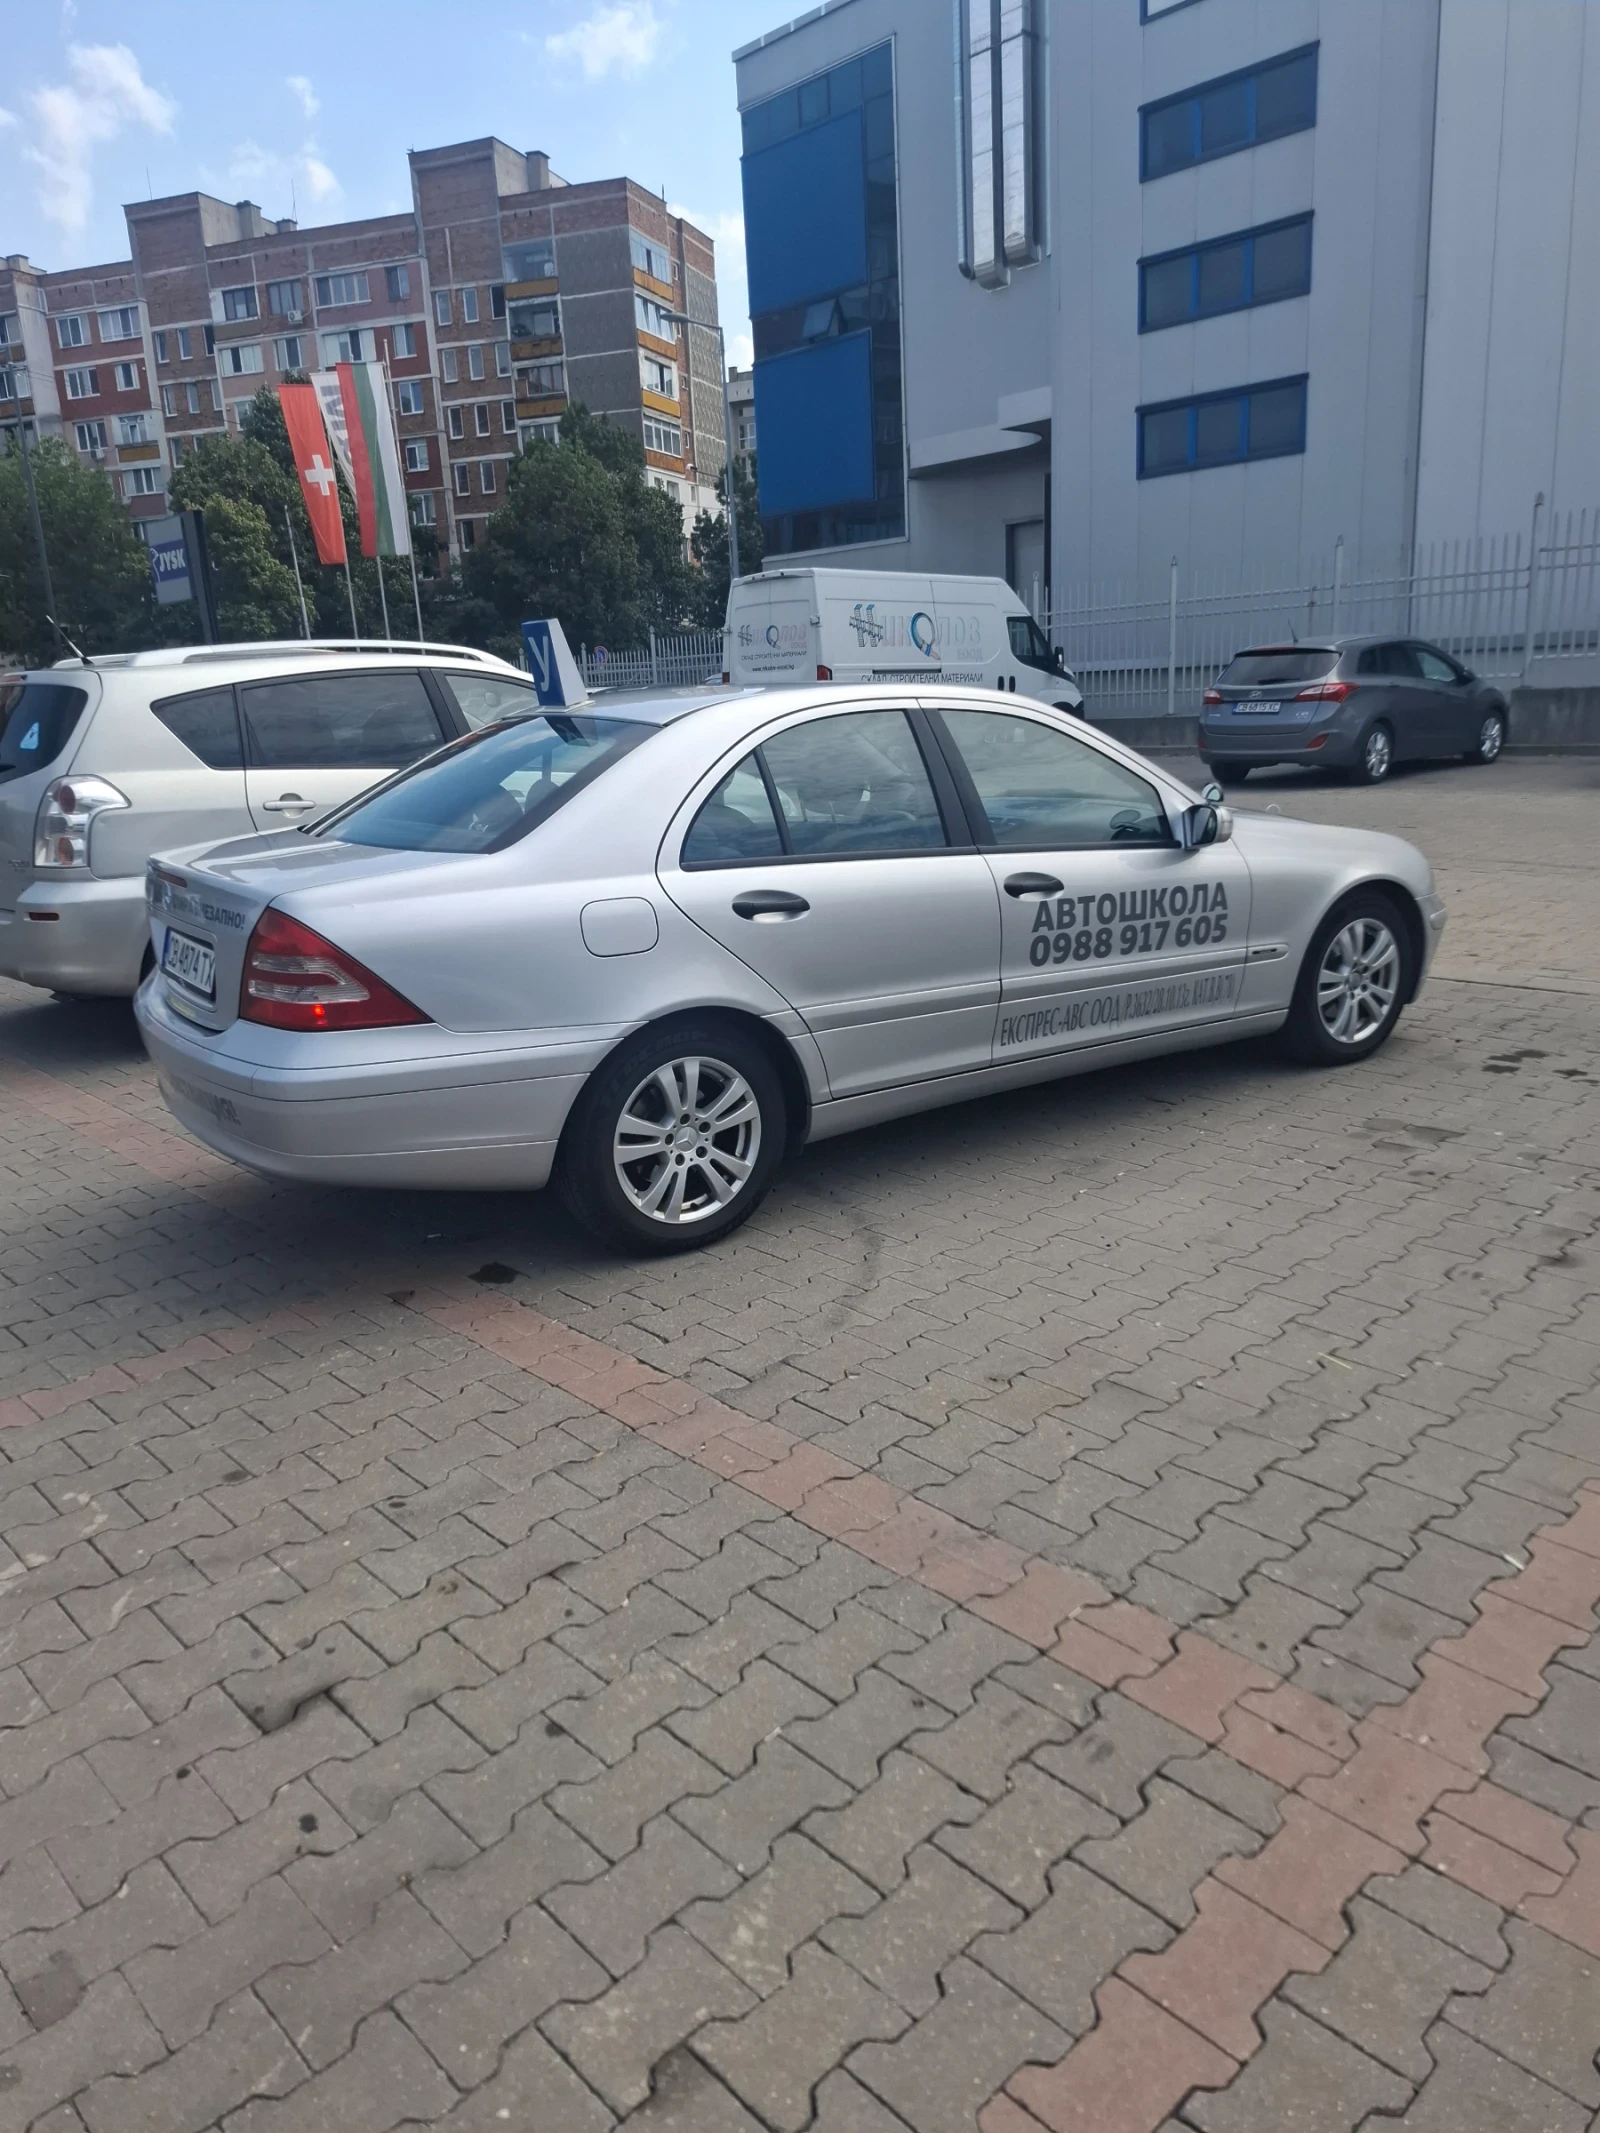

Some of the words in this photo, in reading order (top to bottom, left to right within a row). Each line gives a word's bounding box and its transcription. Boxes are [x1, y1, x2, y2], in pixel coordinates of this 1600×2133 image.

[159, 548, 186, 573] JYSK
[941, 673, 983, 683] МАТЕРИАЛИ
[1031, 881, 1228, 933] АВТОШКОЛА
[1029, 927, 1113, 967] 0988
[1120, 920, 1170, 956] 917
[1174, 913, 1228, 948] 605
[1000, 1001, 1089, 1047] ЕКСПРЕС-АВС
[1090, 995, 1121, 1030] ООД
